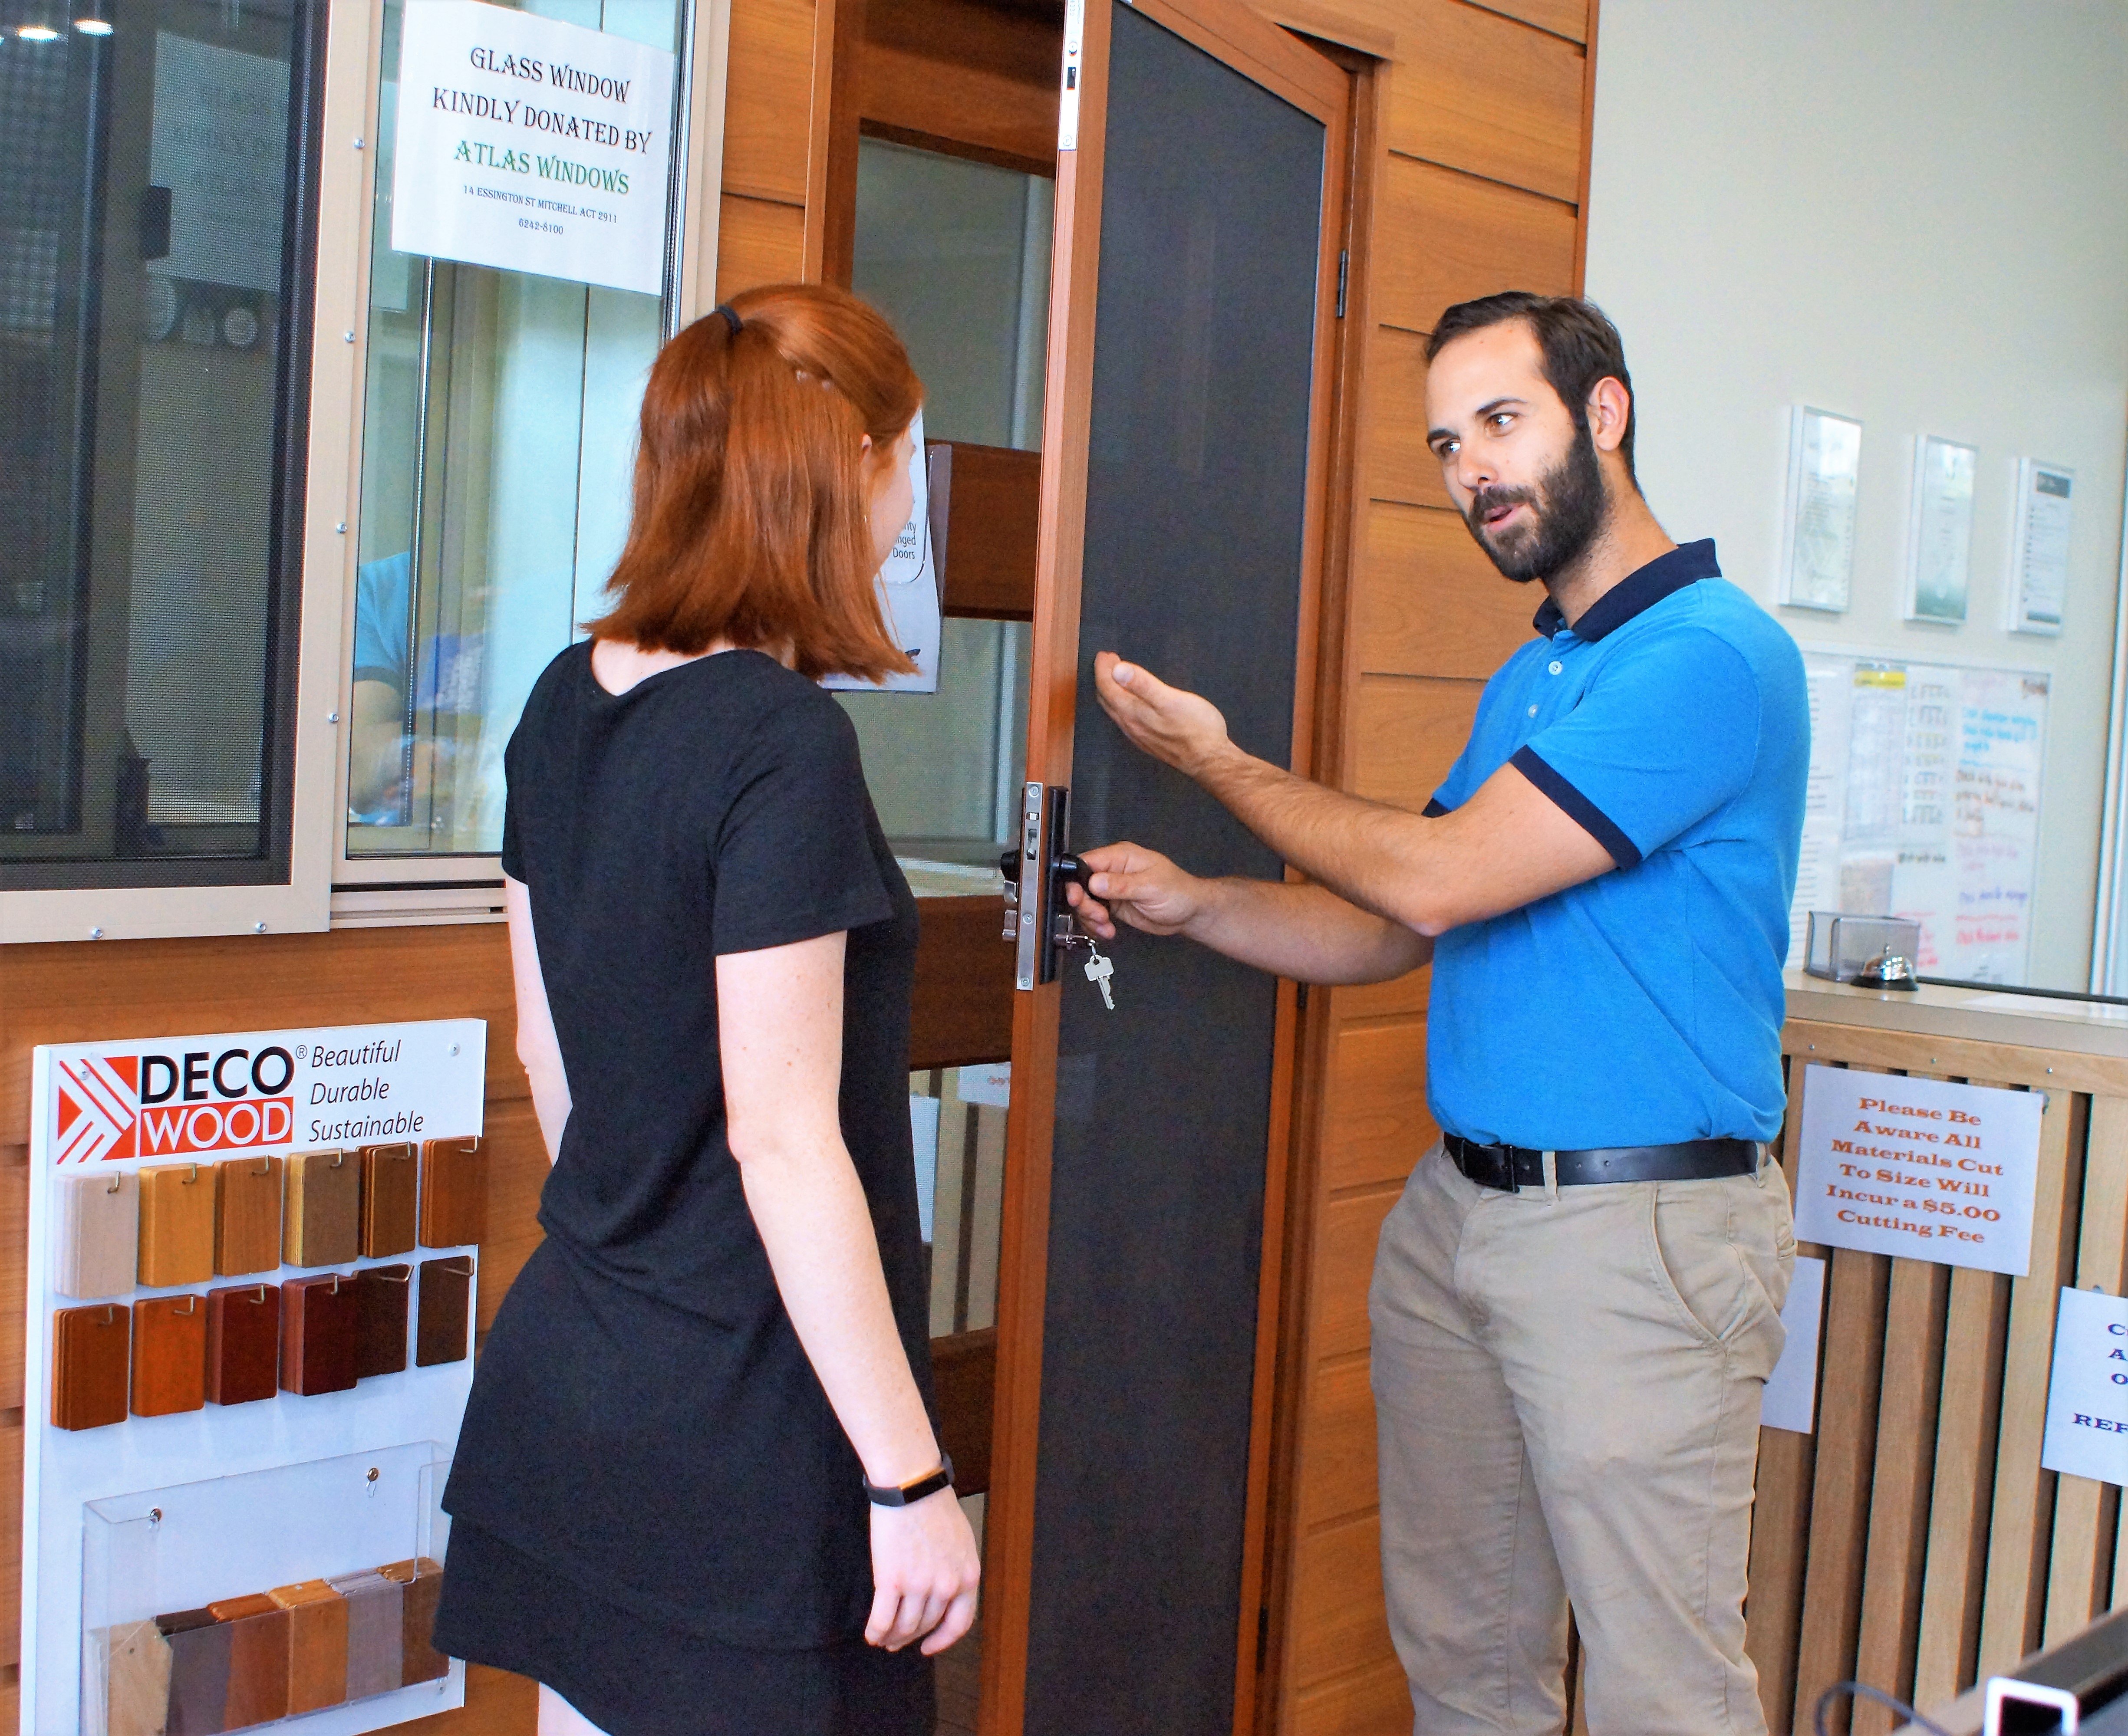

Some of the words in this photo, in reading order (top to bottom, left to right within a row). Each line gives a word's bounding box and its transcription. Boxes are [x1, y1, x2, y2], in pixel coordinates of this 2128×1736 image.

[471, 47, 544, 82] GLASS
[550, 63, 631, 104] WINDOW
[432, 87, 520, 124] KINDLY
[524, 106, 619, 147] DONATED
[625, 130, 652, 156] BY
[455, 140, 530, 174] ATLAS
[536, 155, 629, 195] WINDOWS
[464, 185, 474, 195] 14
[478, 187, 523, 204] ESSINGTON
[525, 197, 536, 207] ST
[538, 200, 577, 214] MITCHELL
[580, 207, 596, 220] ACT
[598, 212, 617, 223] 2911
[519, 218, 563, 234] 6242-8100
[893, 547, 915, 559] Doors
[311, 1040, 401, 1067] Beautiful
[141, 1046, 294, 1104] DECO
[310, 1078, 389, 1105] Durable
[144, 1101, 292, 1152] WOOD
[309, 1111, 424, 1144] Sustainable
[1858, 1098, 1942, 1120] Please
[1948, 1110, 1981, 1125] Be
[1853, 1120, 1939, 1142] Aware
[1944, 1133, 1980, 1148] All
[1832, 1139, 1952, 1168] Materials
[1957, 1159, 2003, 1175] Cut
[1839, 1163, 1871, 1179] To
[1876, 1169, 1930, 1187] Size
[1937, 1177, 1989, 1197] Will
[1827, 1184, 1898, 1205] Incur
[1903, 1200, 1917, 1209] a
[1923, 1199, 2000, 1222] $5.00
[1837, 1209, 1933, 1238] Cutting
[1938, 1225, 1985, 1243] Fee
